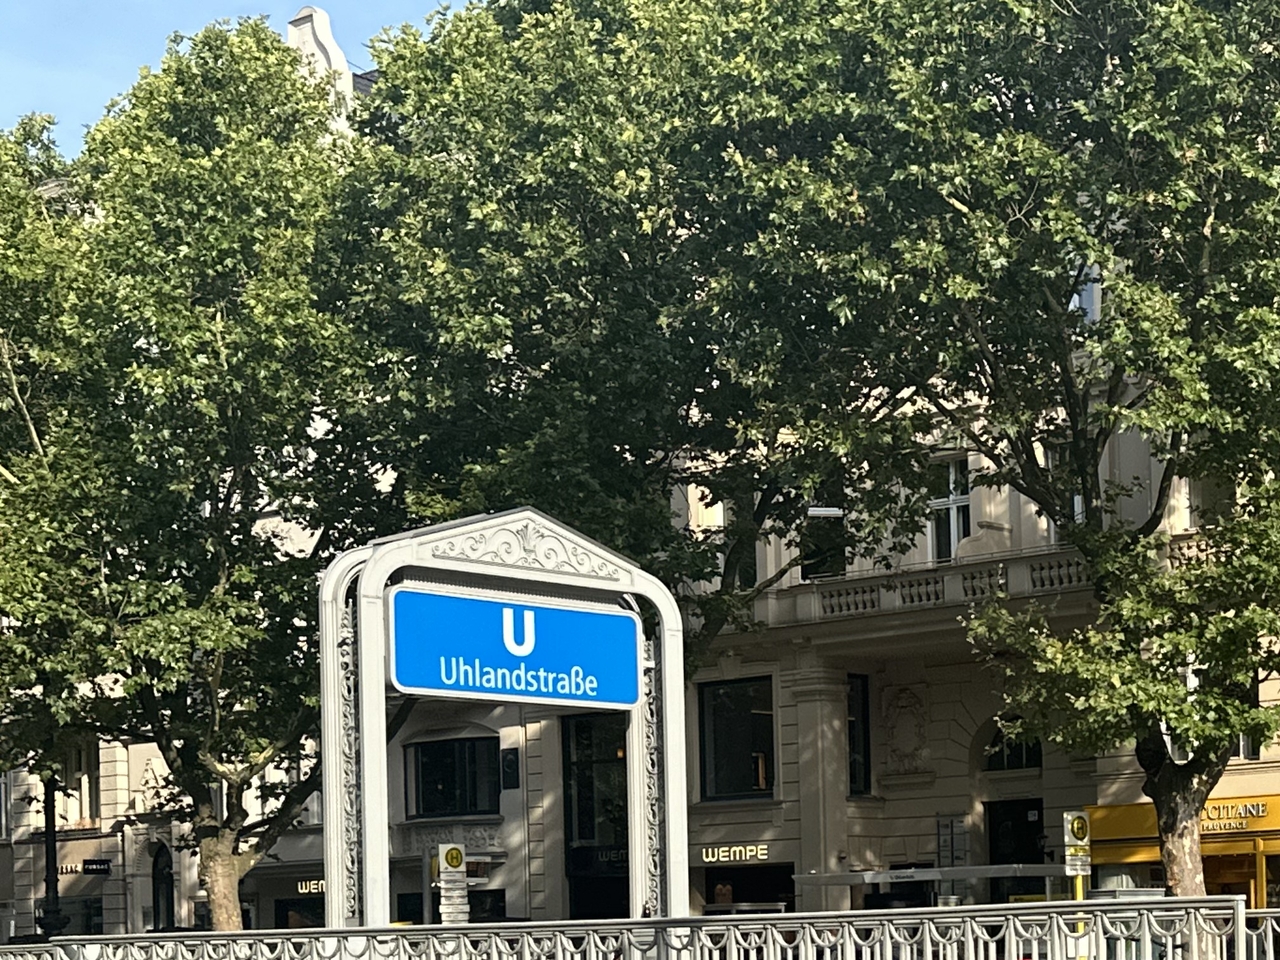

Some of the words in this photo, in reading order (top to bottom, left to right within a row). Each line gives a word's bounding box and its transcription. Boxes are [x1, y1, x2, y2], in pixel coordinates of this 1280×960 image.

[502, 607, 536, 657] U
[439, 655, 598, 697] Uhlandstraße
[702, 844, 768, 862] WEMPE
